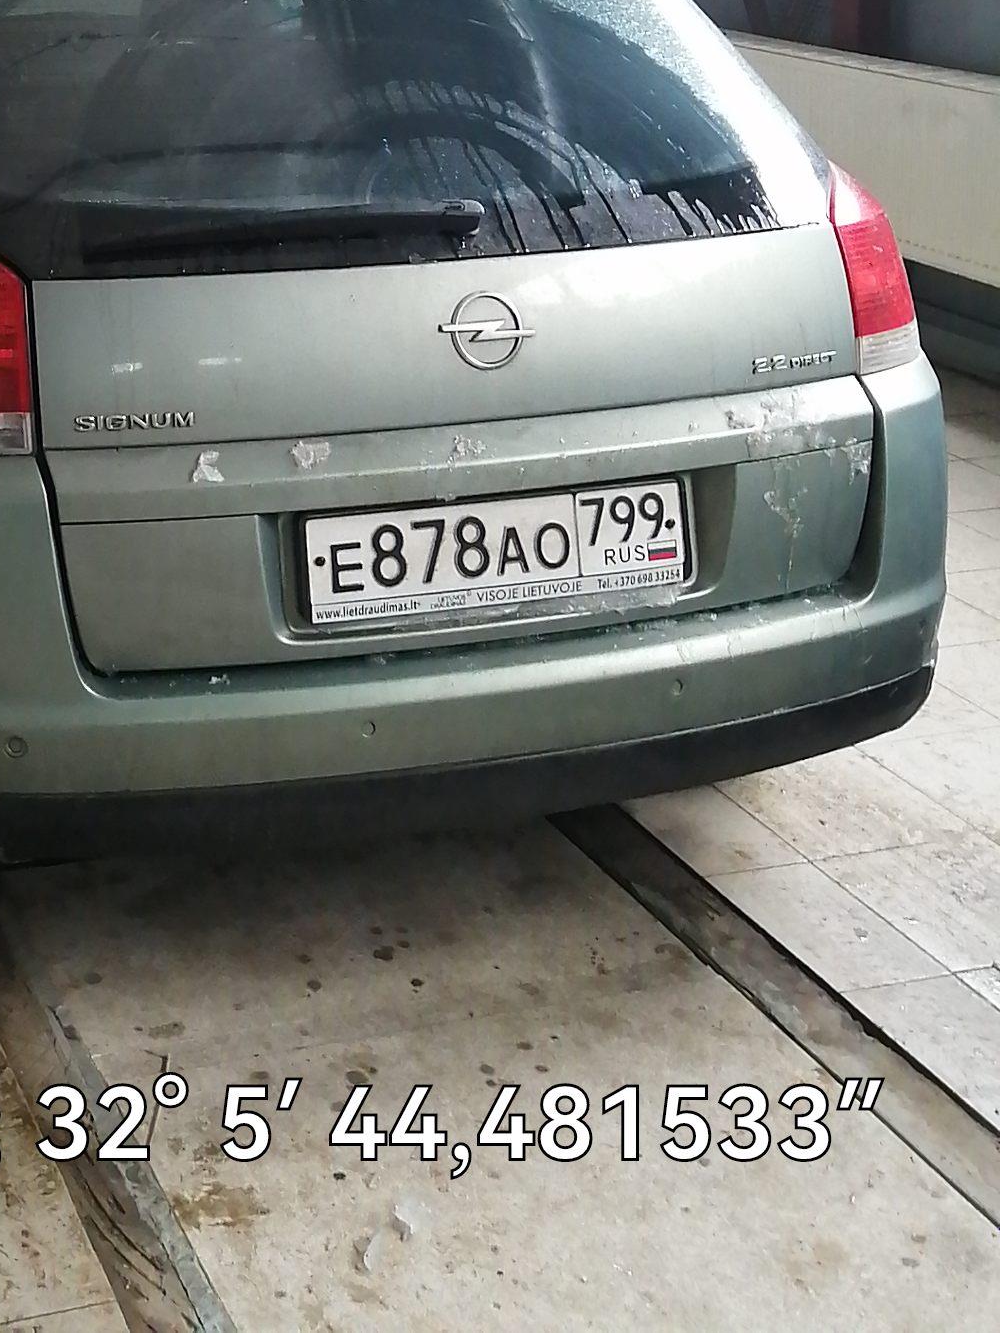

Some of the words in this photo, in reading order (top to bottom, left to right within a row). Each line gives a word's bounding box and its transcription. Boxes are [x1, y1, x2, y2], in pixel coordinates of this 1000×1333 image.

[74, 411, 195, 432] SIGNUM
[330, 515, 570, 594] E878AO
[579, 492, 664, 546] 799
[604, 545, 645, 565] RUS
[477, 589, 518, 602] VISOJE
[522, 581, 582, 598] LIETUVOJE
[597, 578, 612, 590] Tel.
[316, 600, 418, 619] www.lietdraudimas.lt
